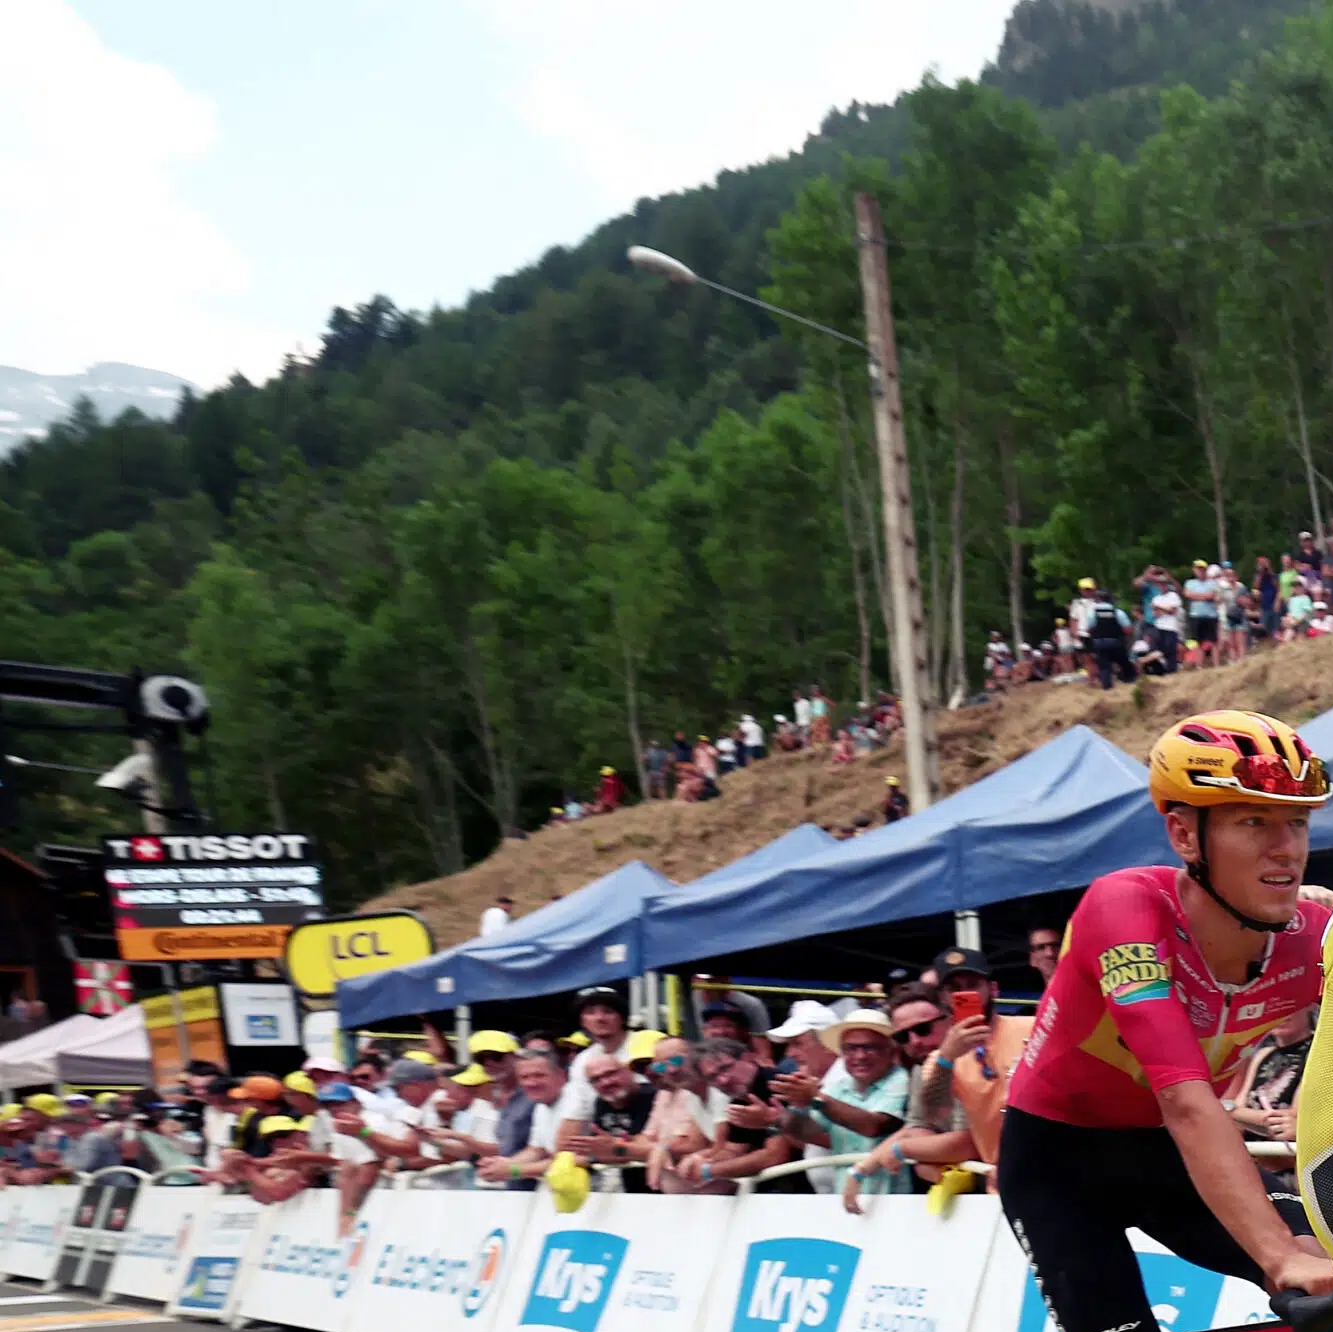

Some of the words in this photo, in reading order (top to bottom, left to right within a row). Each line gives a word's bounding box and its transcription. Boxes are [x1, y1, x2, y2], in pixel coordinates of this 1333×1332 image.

[1196, 757, 1225, 768] sweet
[161, 834, 308, 861] TISSOT
[329, 931, 391, 960] LCL
[535, 1247, 609, 1314] Krys
[864, 1283, 928, 1309] OPTIQUE
